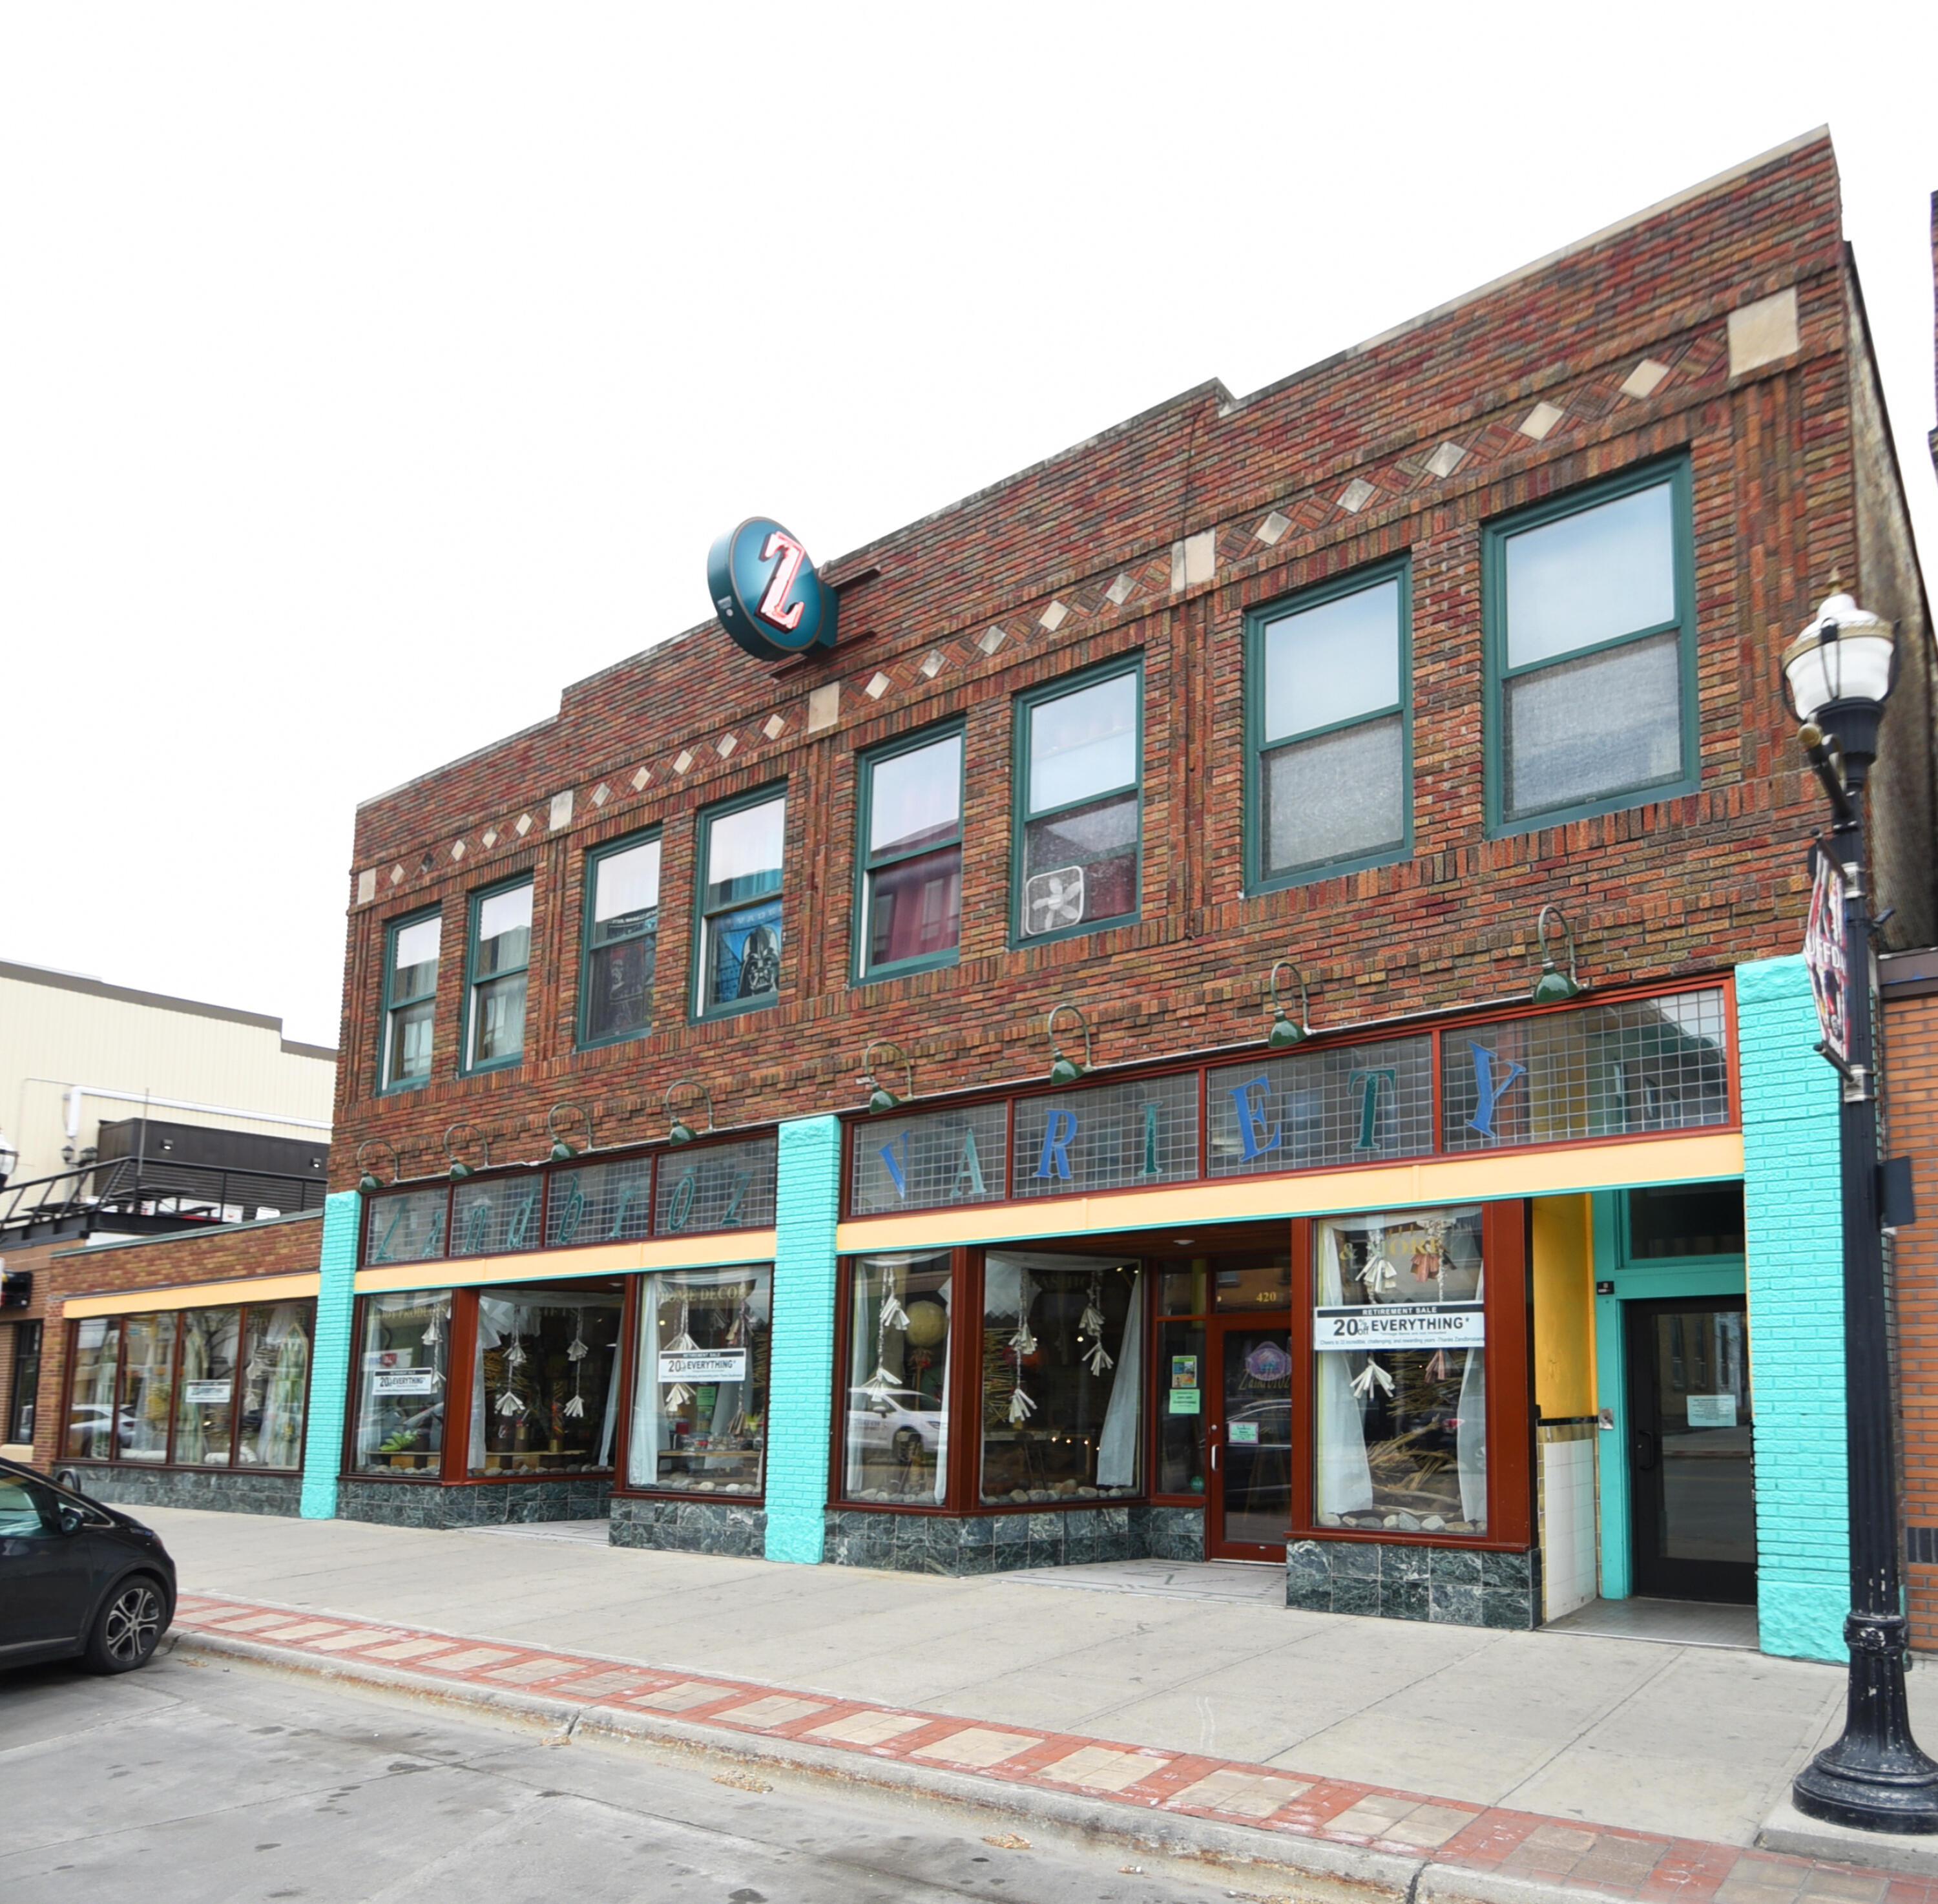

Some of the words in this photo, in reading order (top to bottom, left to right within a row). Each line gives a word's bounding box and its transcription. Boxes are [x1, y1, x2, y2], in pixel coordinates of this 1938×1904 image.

[758, 530, 806, 631] Z
[879, 1040, 1526, 1200] VARIETY
[1256, 1292, 1276, 1302] 420
